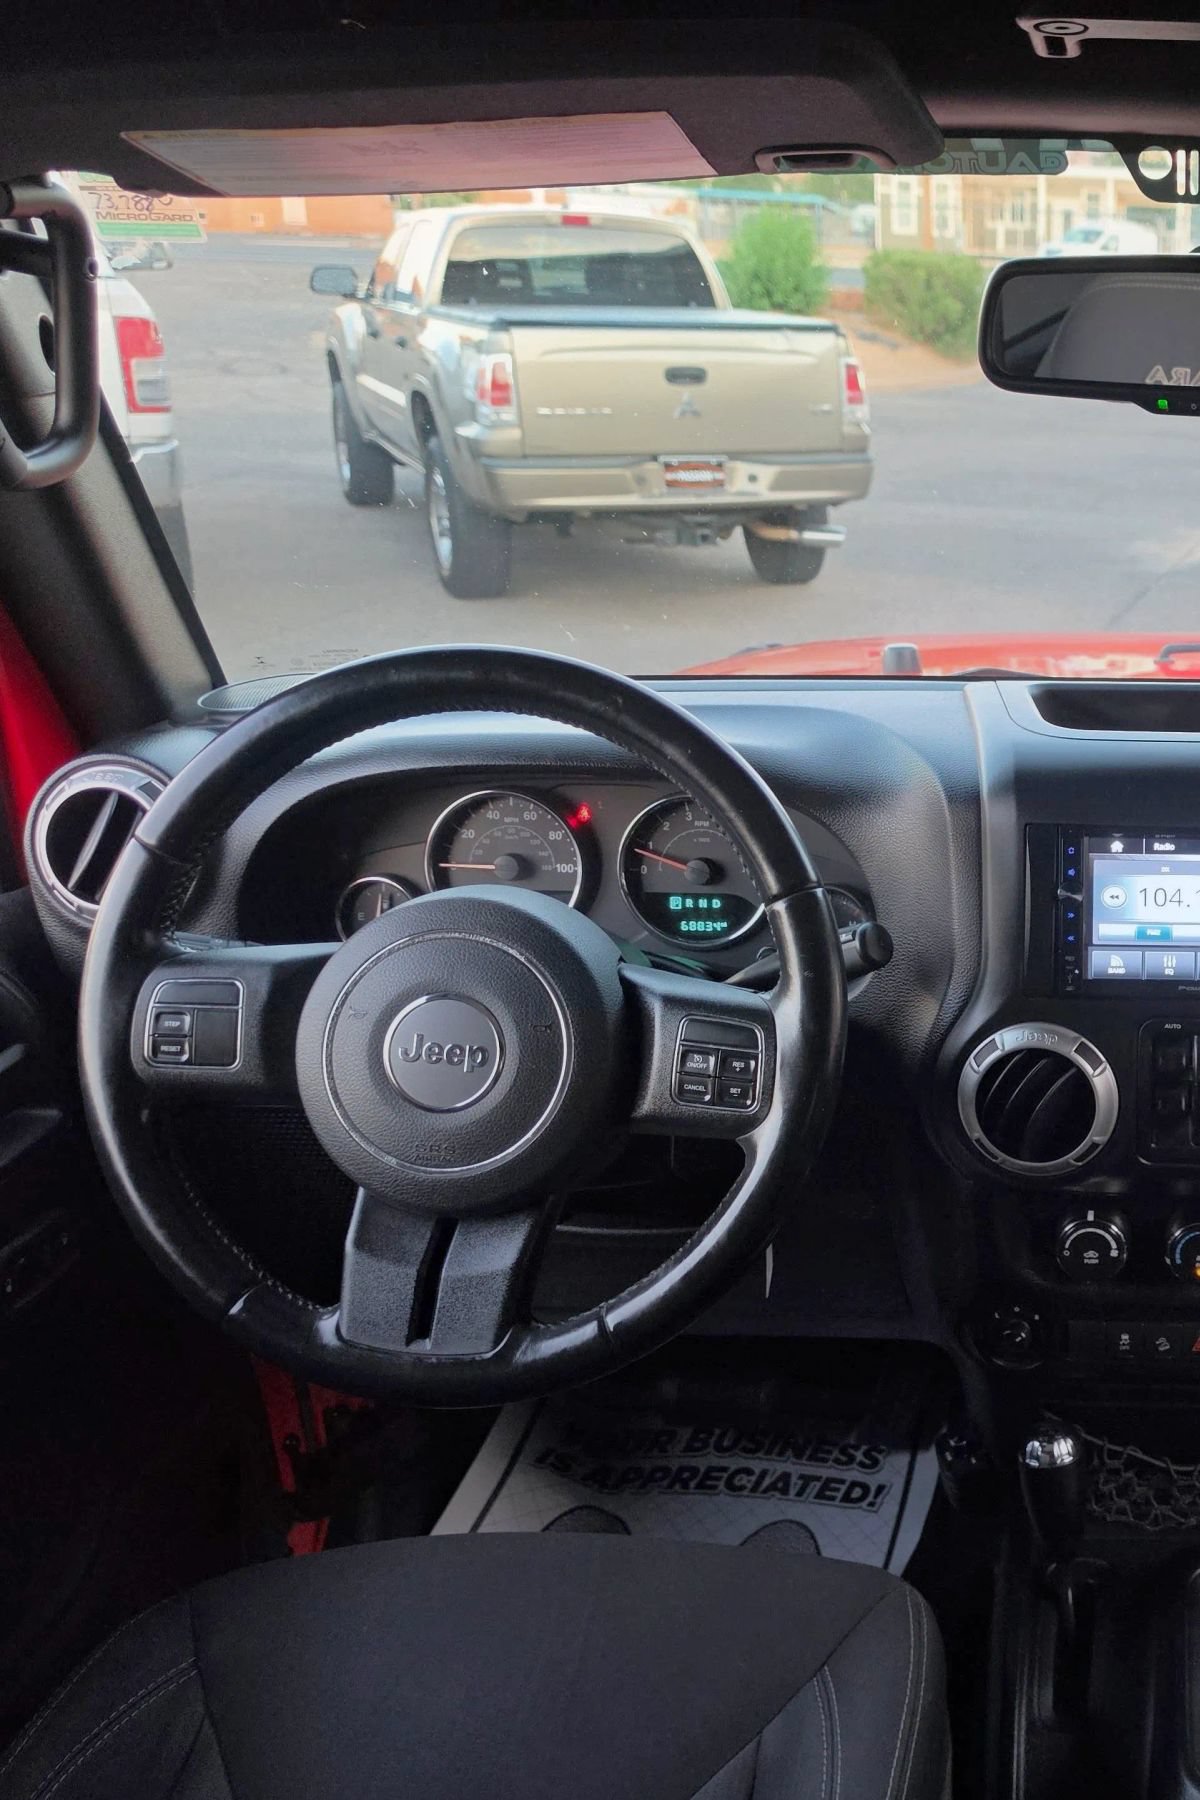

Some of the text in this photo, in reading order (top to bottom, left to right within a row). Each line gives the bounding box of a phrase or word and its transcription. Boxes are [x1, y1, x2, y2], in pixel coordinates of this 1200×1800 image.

[486, 811, 500, 820] 40
[523, 811, 537, 821] 60
[686, 812, 692, 821] 3
[663, 822, 670, 831] 2
[461, 829, 475, 839] 20
[549, 831, 562, 841] 80
[648, 841, 653, 849] 1
[1153, 842, 1176, 851] Radio
[555, 863, 574, 873] 100
[641, 865, 648, 874] 0
[685, 898, 693, 908] R
[699, 898, 707, 908] N
[712, 898, 721, 908] D
[358, 912, 365, 920] E
[399, 1033, 489, 1072] Jeep
[683, 1083, 706, 1091] CANCEL
[681, 1426, 887, 1471] BUSINESS
[533, 1448, 890, 1508] IS APPRECIATED!
